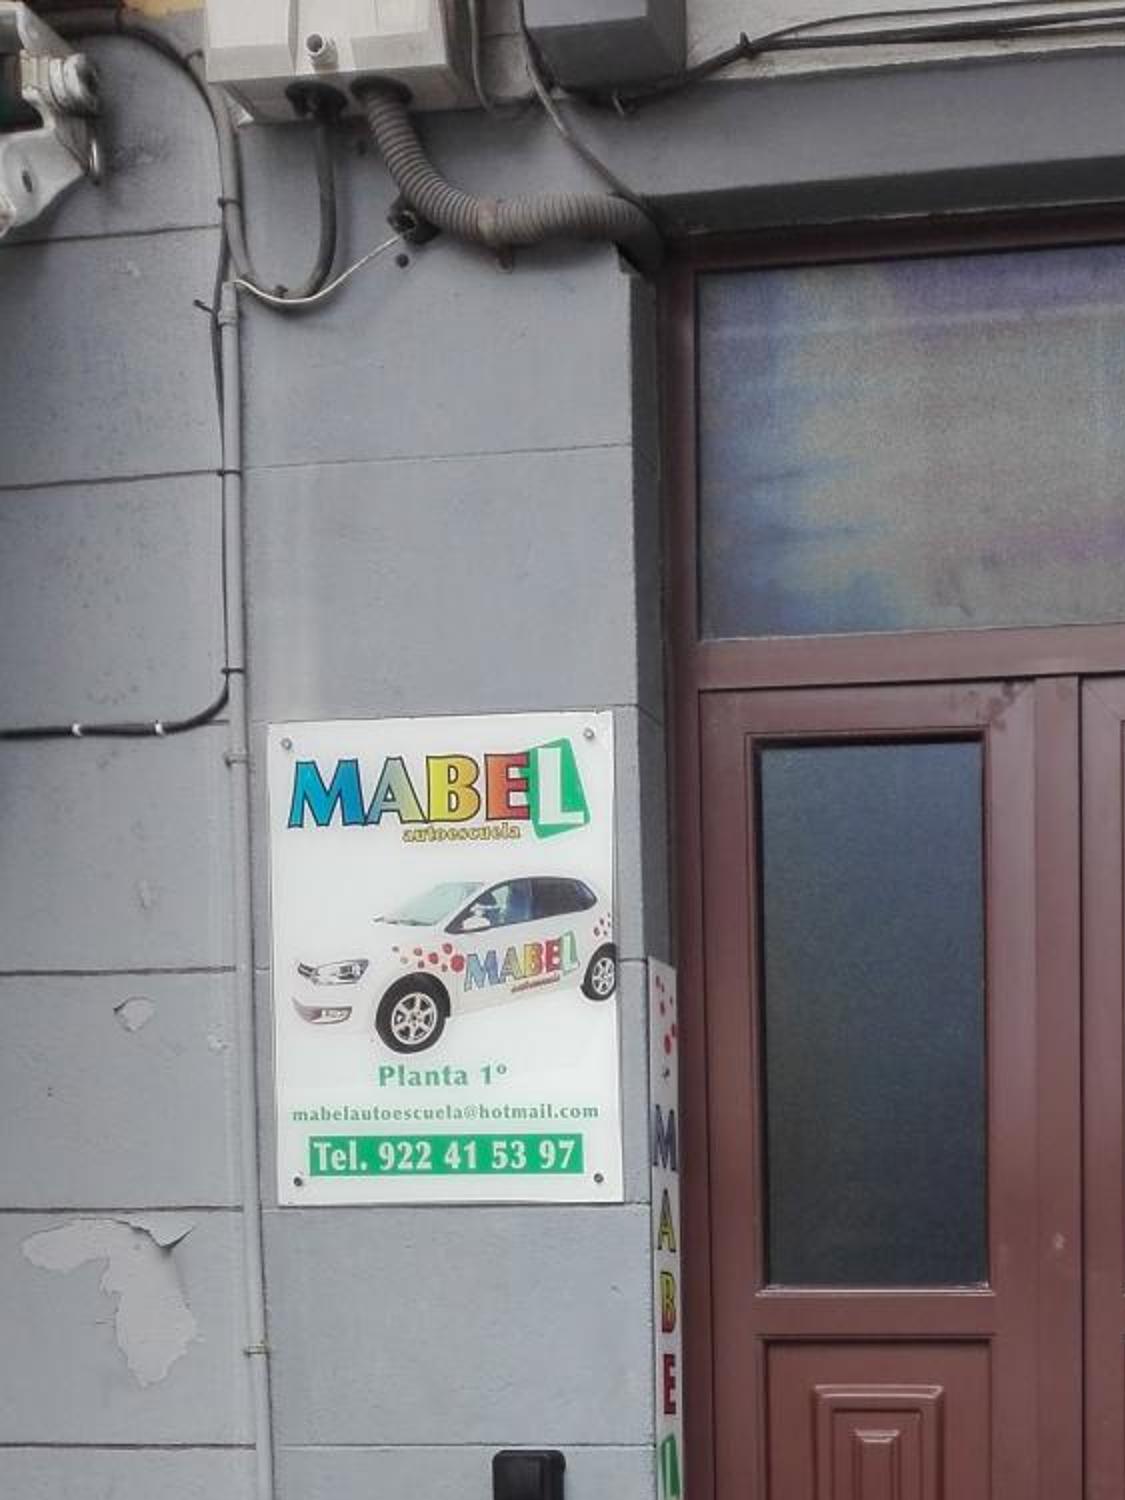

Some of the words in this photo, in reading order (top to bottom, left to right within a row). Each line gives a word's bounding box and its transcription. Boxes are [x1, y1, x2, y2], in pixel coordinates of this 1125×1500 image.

[287, 744, 590, 829] MABEL
[402, 822, 521, 843] autoescuela
[379, 1064, 469, 1088] Planta
[292, 1103, 600, 1122] mabelautoescuela@hotmail.com
[313, 1142, 368, 1171] Tel.
[378, 1141, 433, 1171] 922
[443, 1140, 478, 1170] 41
[491, 1140, 527, 1170] 53
[539, 1139, 576, 1169] 97
